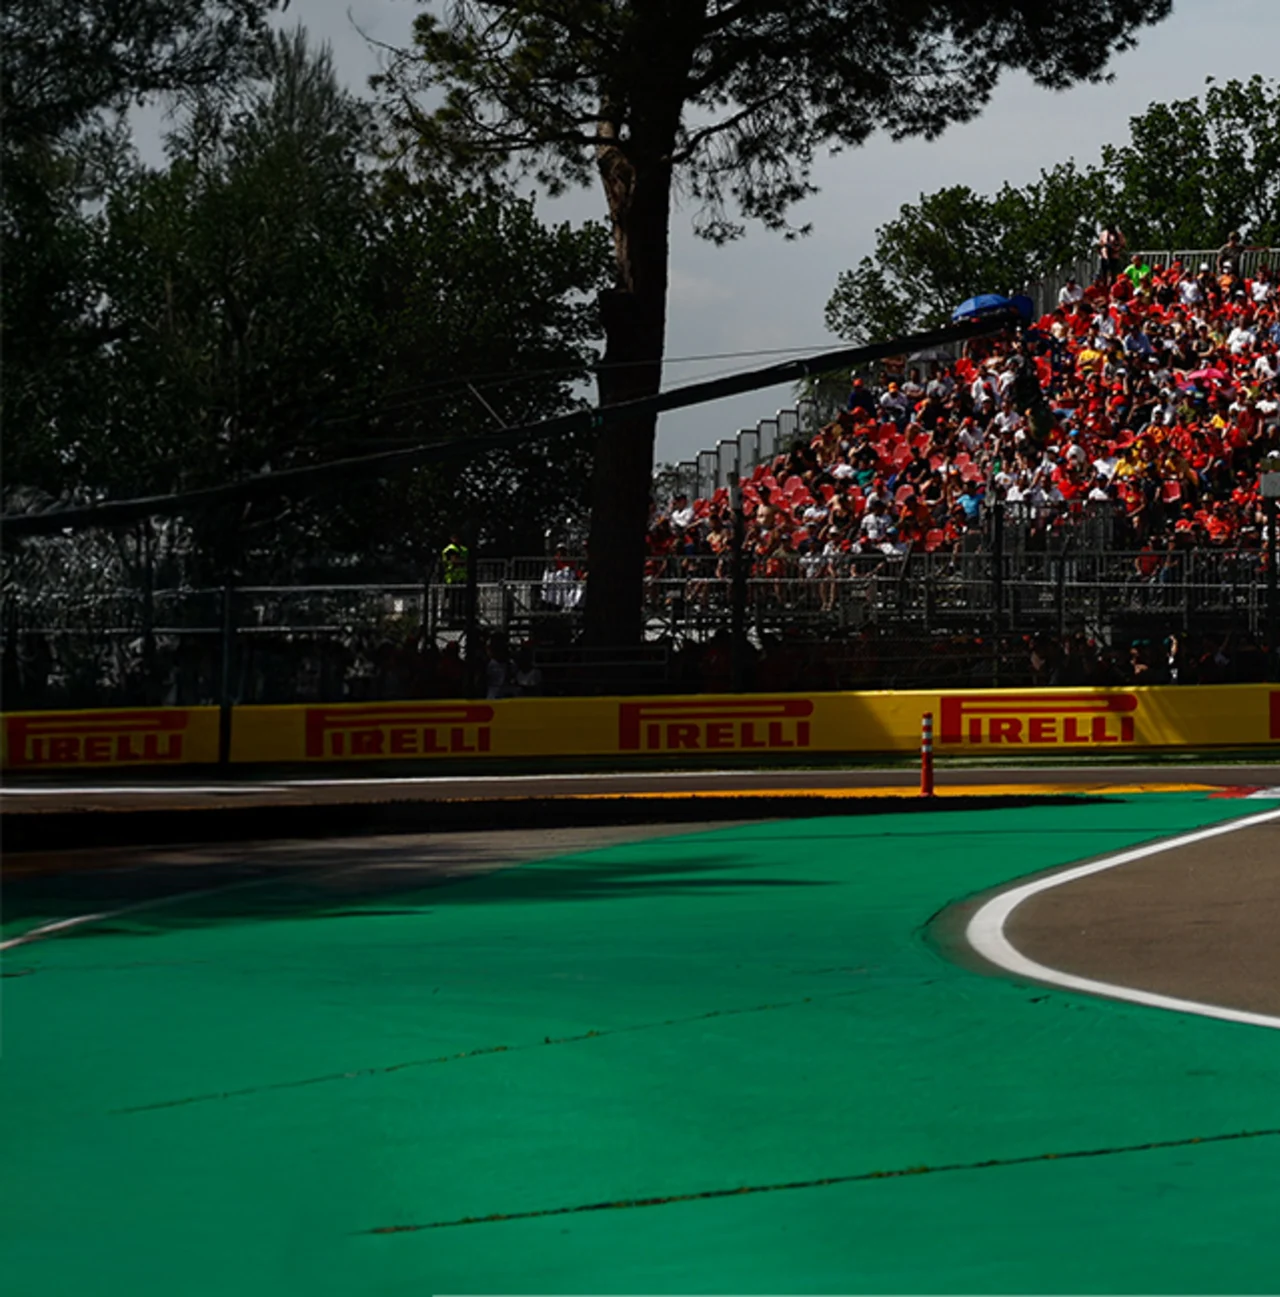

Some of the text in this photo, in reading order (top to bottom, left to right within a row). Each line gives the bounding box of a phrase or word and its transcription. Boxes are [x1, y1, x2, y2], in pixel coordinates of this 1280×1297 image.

[7, 710, 189, 766] PIRELLI
[306, 704, 495, 757] PIRELLI
[619, 699, 814, 751] PIRELLI
[940, 693, 1138, 744] PIRELLI
